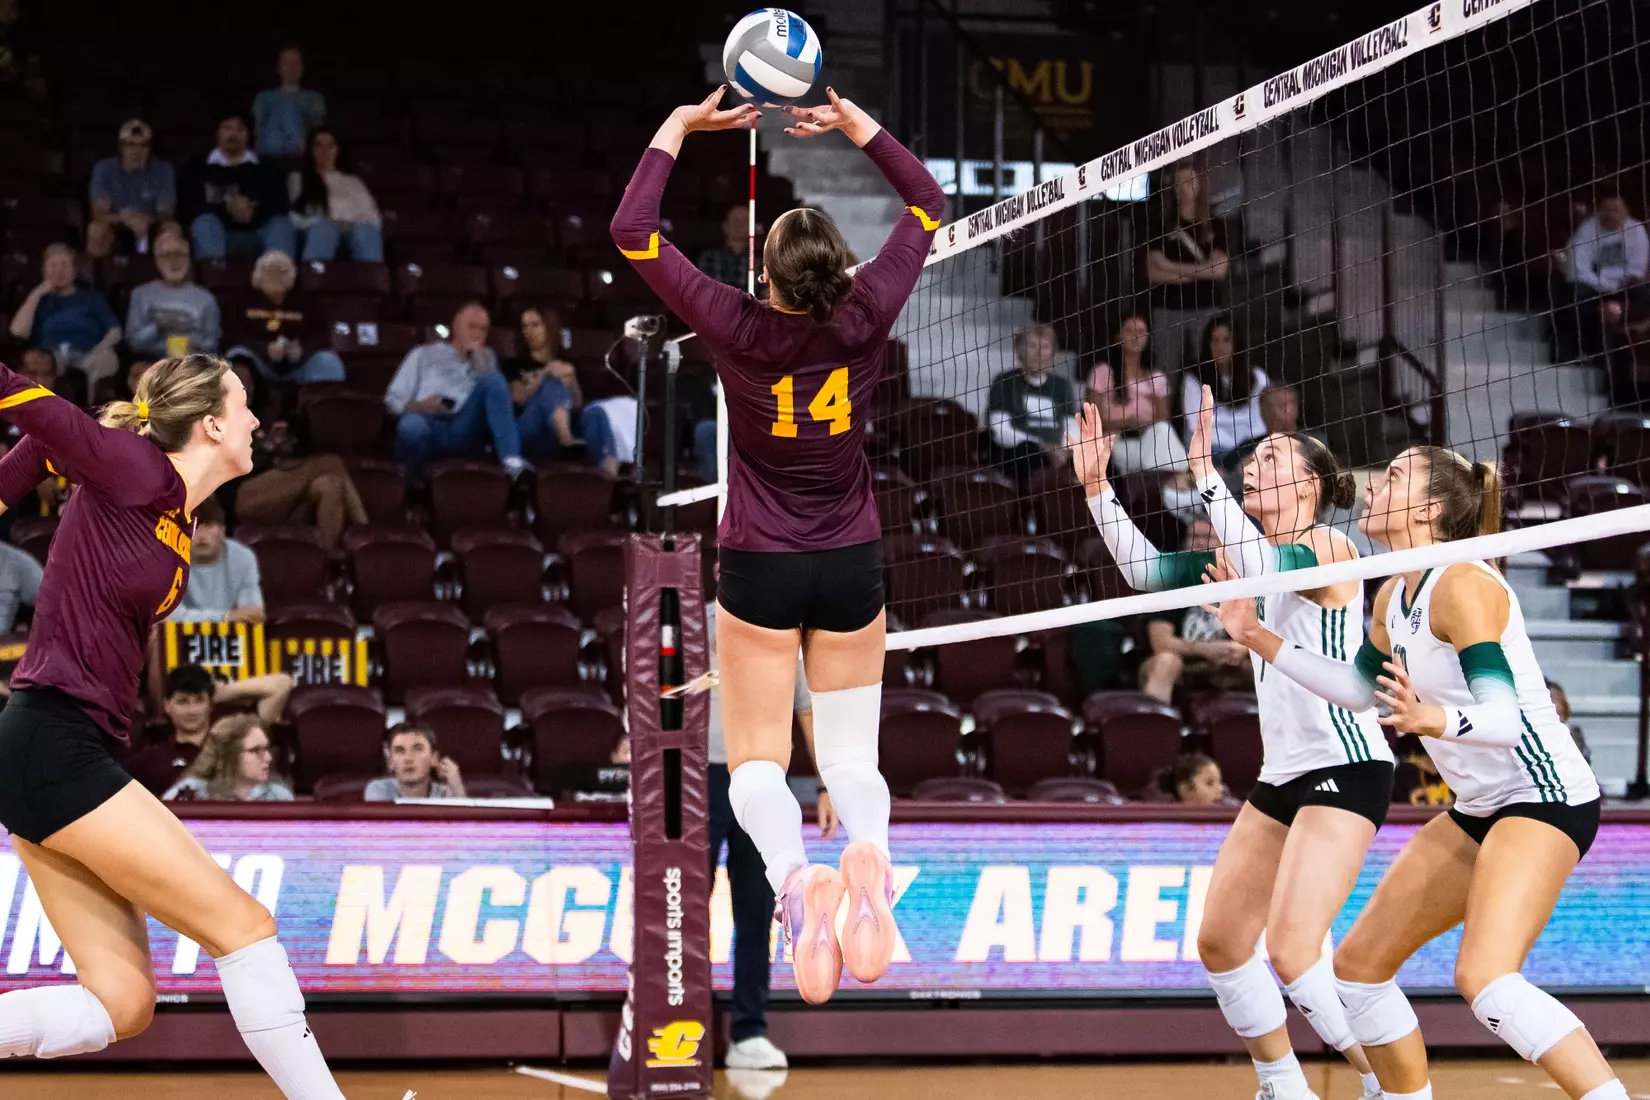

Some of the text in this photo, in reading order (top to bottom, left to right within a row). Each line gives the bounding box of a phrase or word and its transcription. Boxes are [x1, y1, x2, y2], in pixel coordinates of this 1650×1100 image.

[1263, 69, 1301, 109] CENTRAL
[1302, 46, 1347, 92] MICHIGAN
[1350, 18, 1408, 71] VOLLEYBALL
[1101, 145, 1132, 182] CENTRAL
[1134, 129, 1172, 168] MICHIGAN
[1171, 106, 1220, 149] VOLLEYBALL
[967, 209, 993, 239] CENTRAL
[994, 193, 1025, 227] MICHIGAN
[1026, 176, 1065, 215] VOLLEYBALL
[770, 367, 852, 438] 14
[183, 635, 243, 666] FIRE
[286, 653, 347, 685] FIRE
[662, 866, 686, 1006] sports imports
